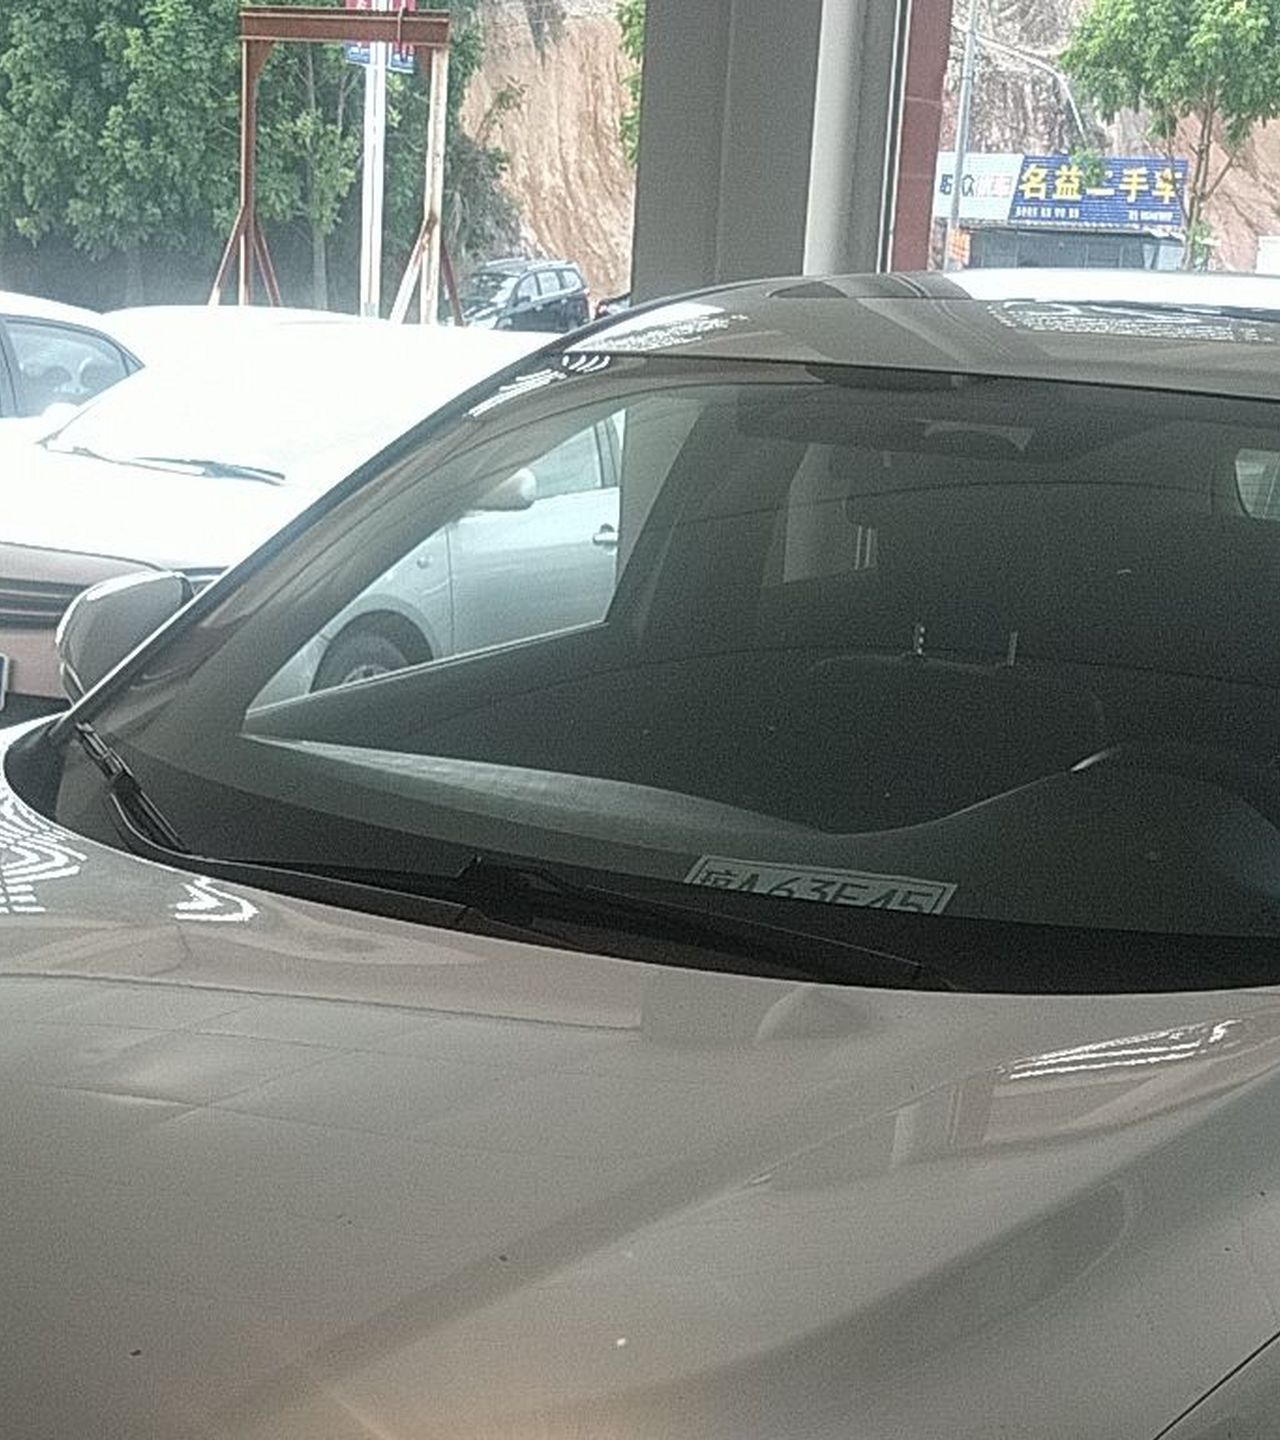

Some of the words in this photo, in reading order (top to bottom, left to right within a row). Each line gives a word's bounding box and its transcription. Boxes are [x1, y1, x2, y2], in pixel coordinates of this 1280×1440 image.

[1019, 164, 1183, 204] 名益二手车
